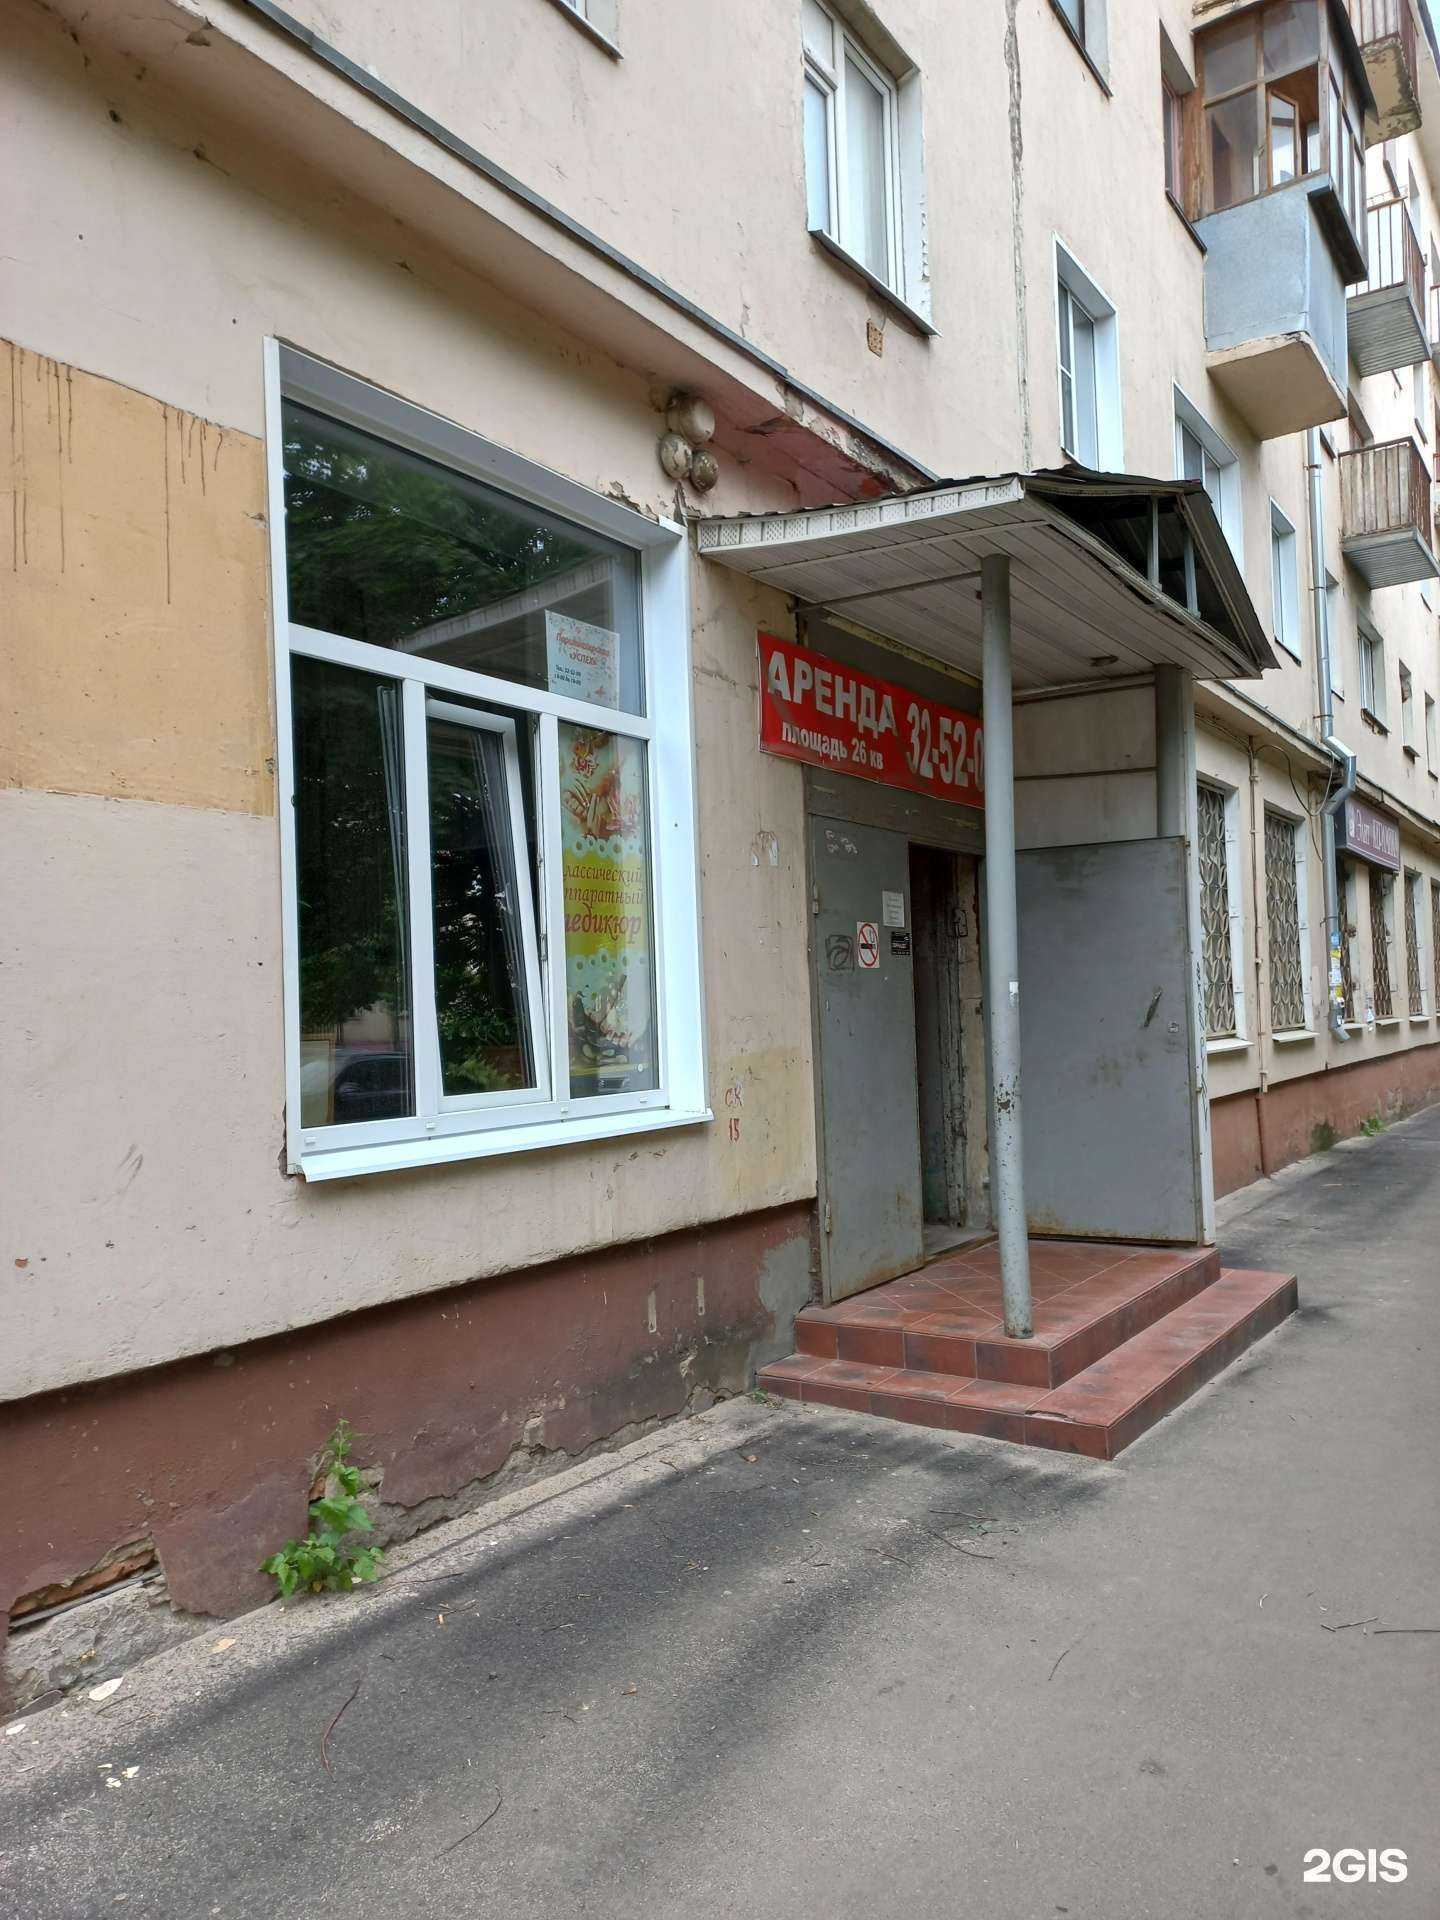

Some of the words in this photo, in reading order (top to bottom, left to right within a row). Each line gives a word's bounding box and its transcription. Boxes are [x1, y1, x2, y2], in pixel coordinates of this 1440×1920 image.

[768, 650, 898, 739] АРЕНДА
[906, 702, 984, 793] 32-52-0
[852, 738, 868, 763] 26
[870, 749, 885, 770] кв
[563, 865, 642, 887] лассический
[564, 887, 643, 908] ппаратный
